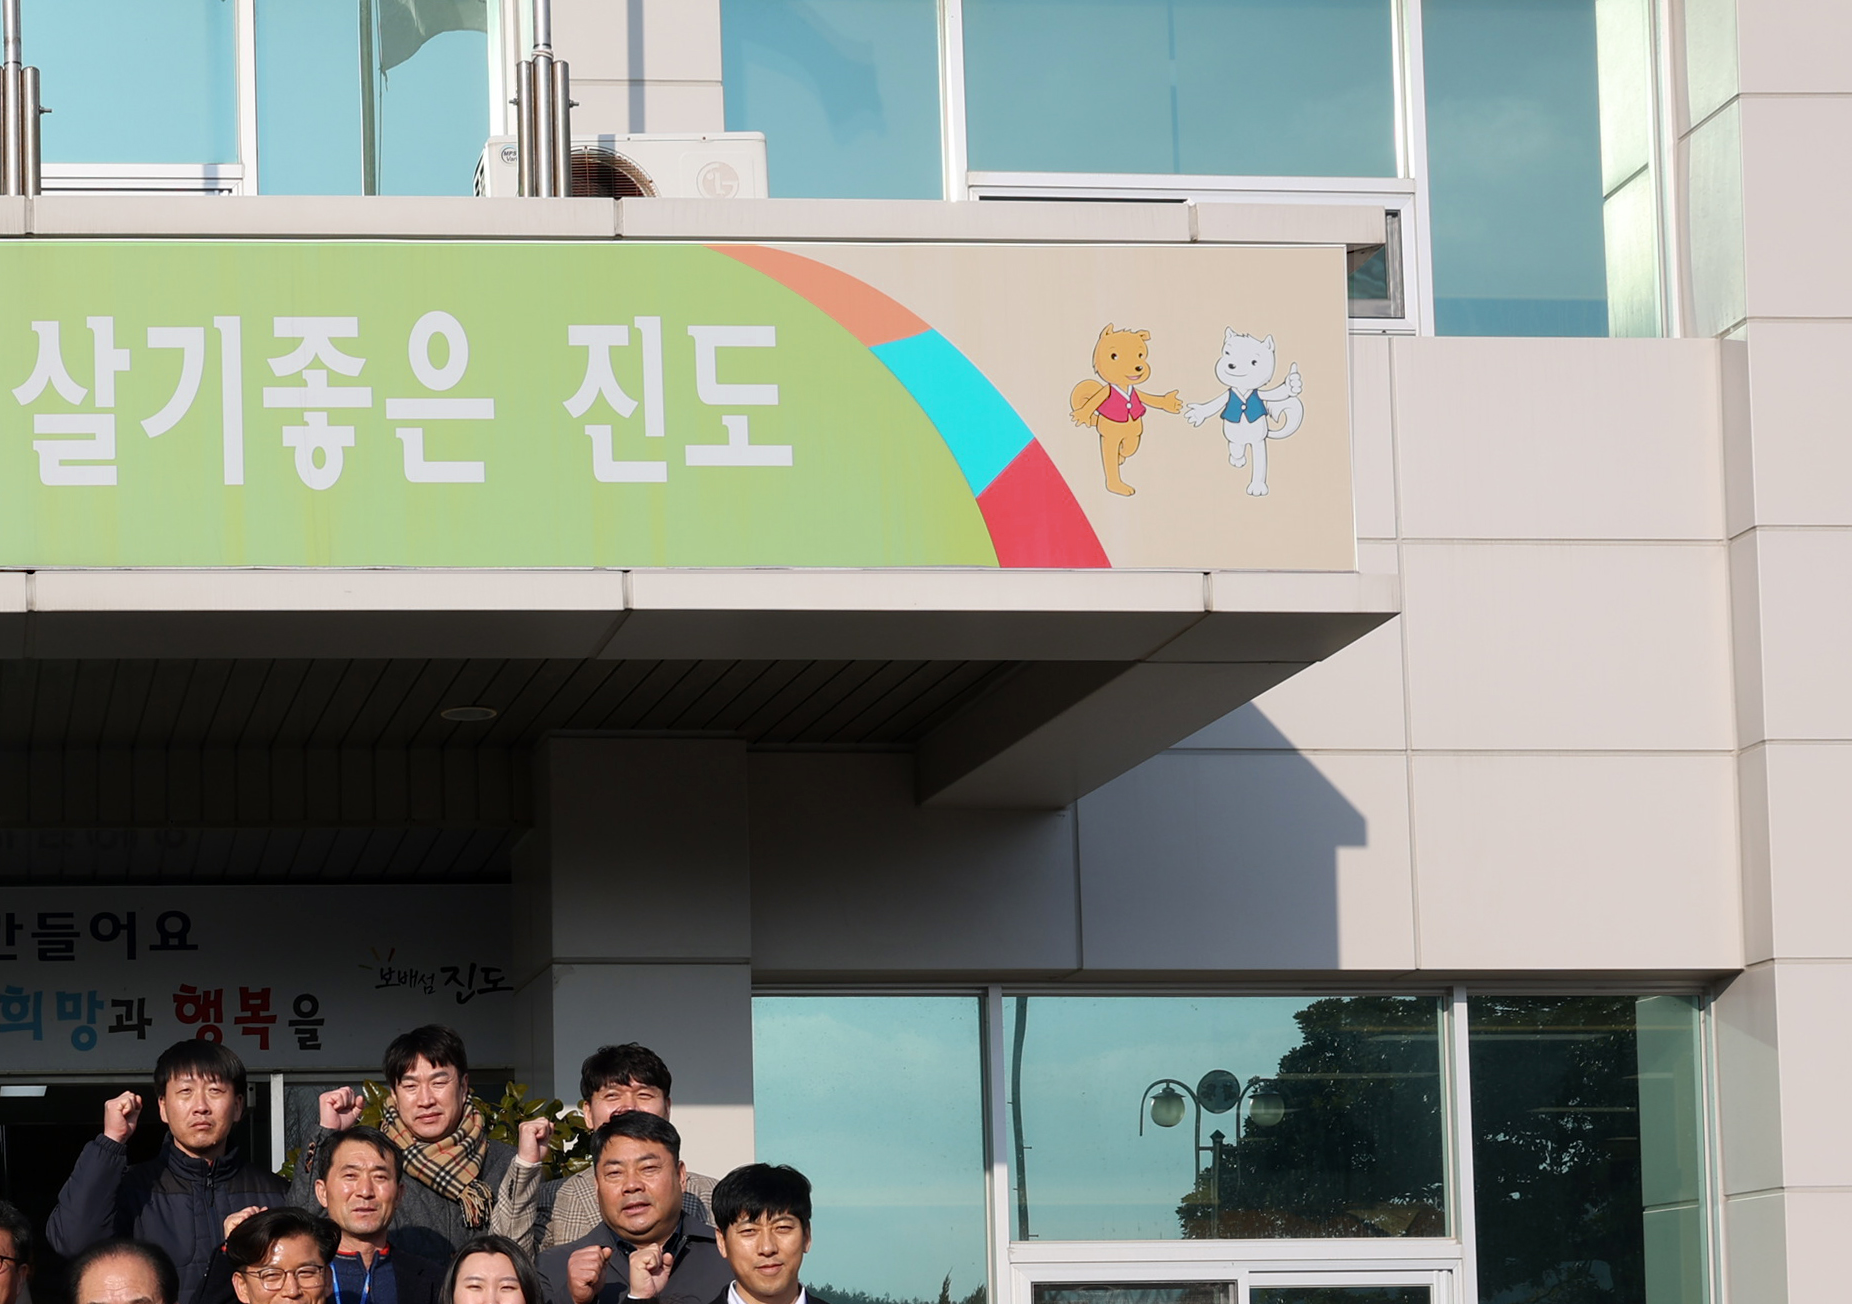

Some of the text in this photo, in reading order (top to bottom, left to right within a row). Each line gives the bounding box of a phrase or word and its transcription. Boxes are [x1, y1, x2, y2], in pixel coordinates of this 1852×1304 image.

[12, 311, 494, 490] 살기좋은
[563, 316, 793, 482] 진도
[375, 963, 514, 1004] 보배섬 진도
[173, 984, 325, 1050] 행복을
